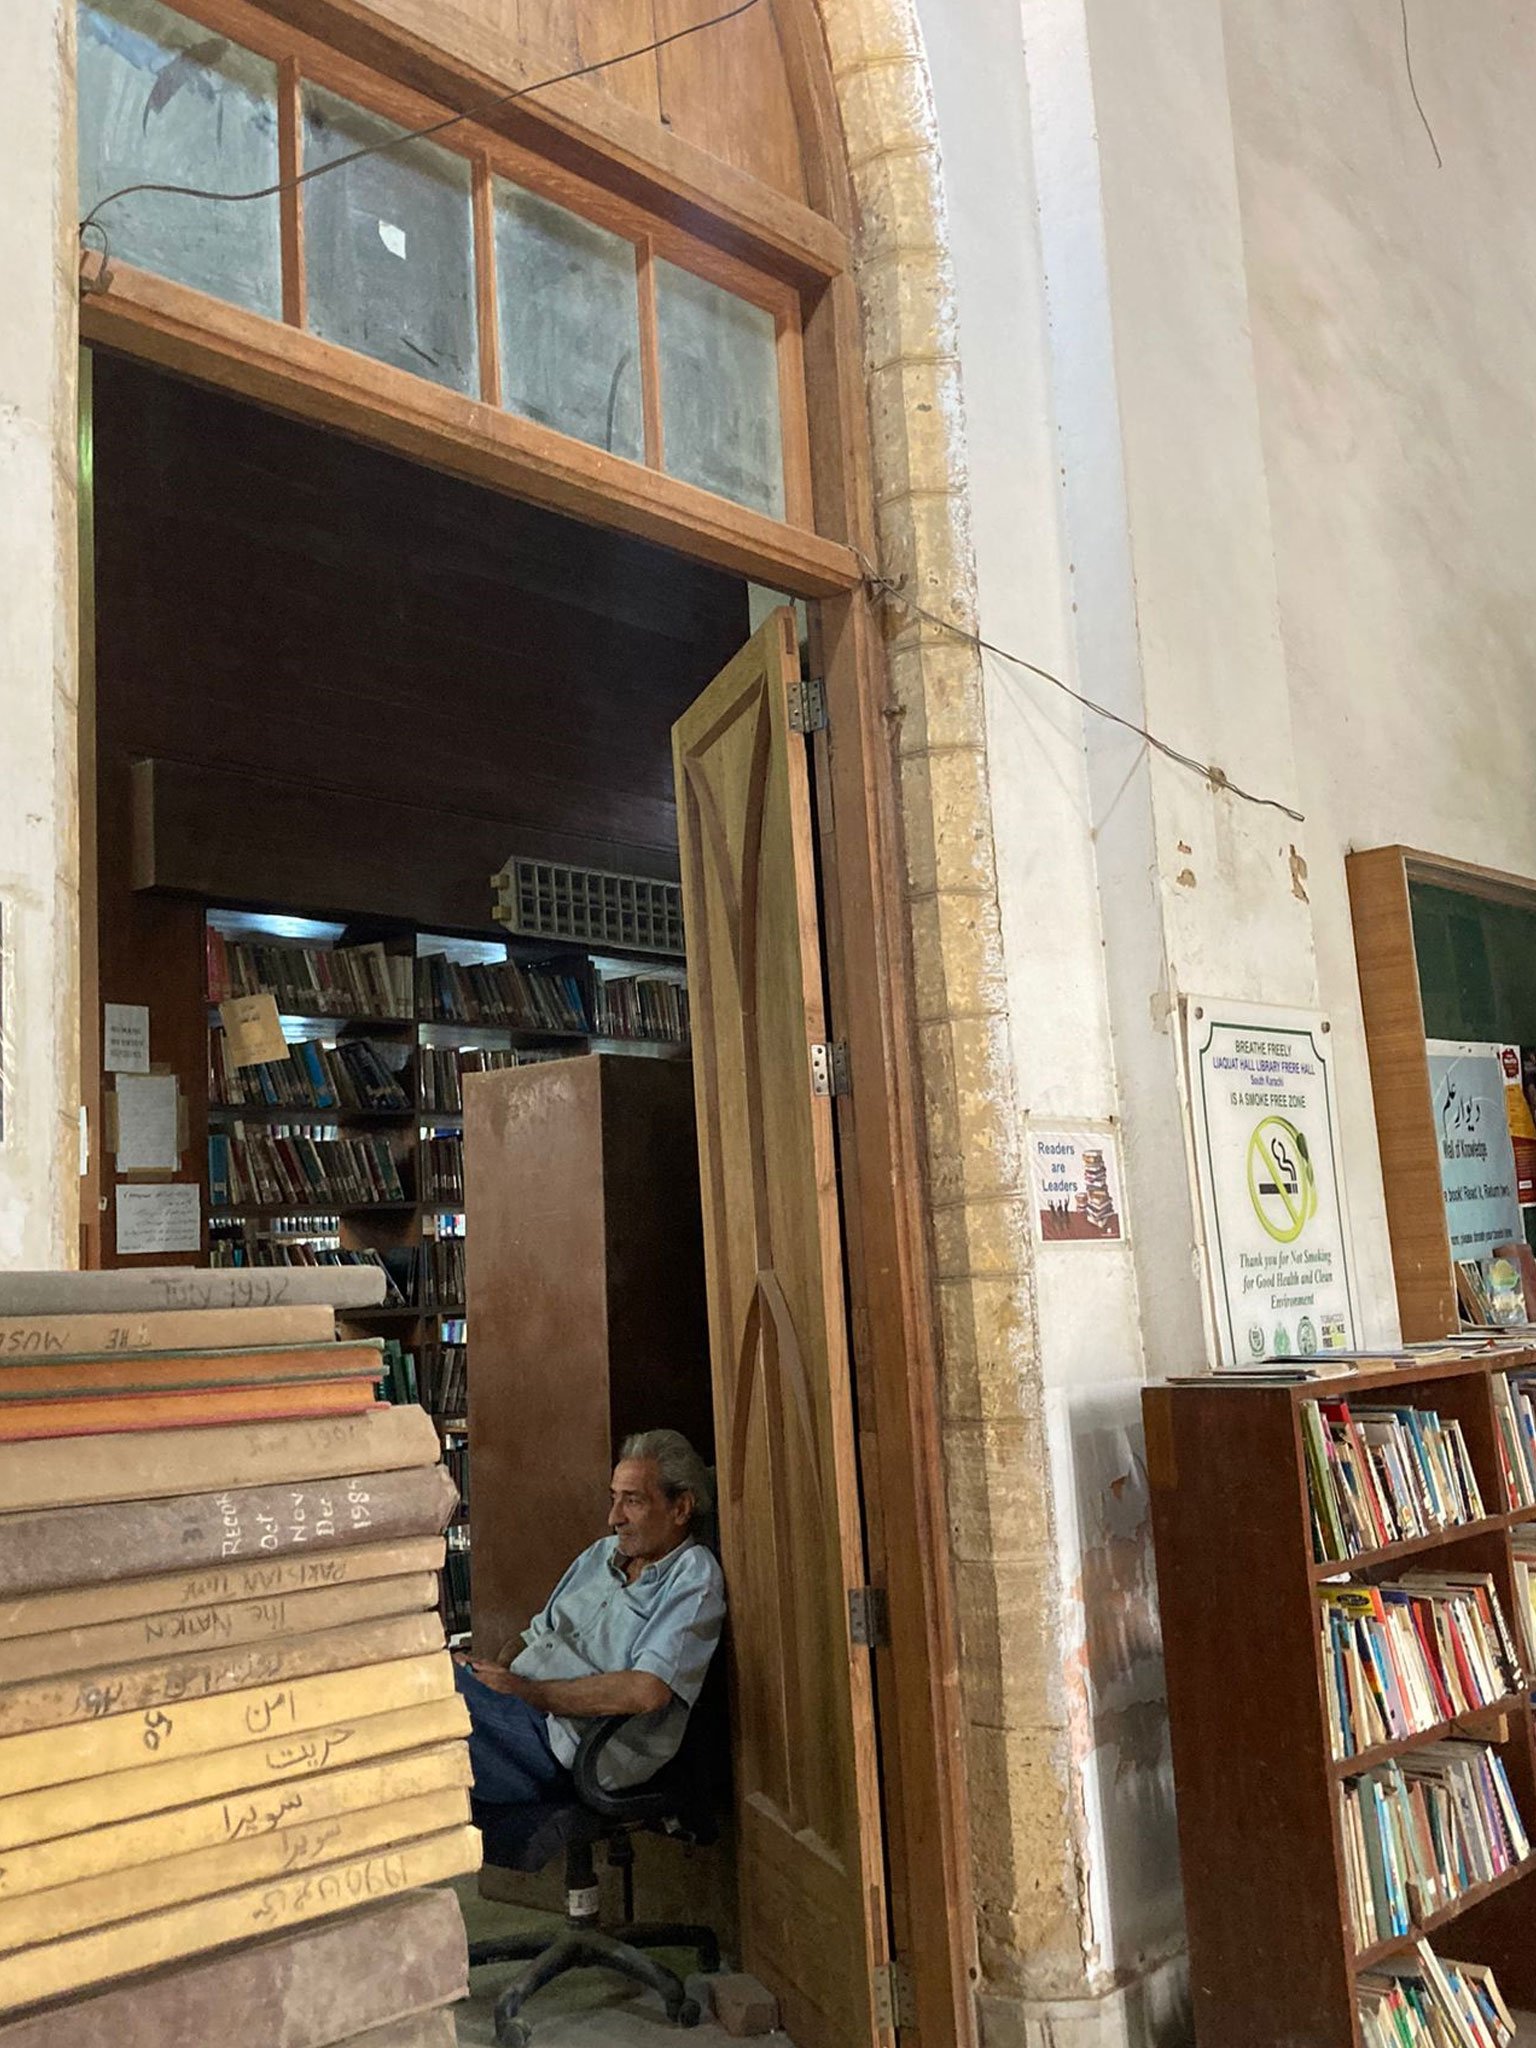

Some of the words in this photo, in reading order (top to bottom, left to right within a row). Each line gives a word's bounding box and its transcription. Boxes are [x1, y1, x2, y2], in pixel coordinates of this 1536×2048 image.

[1235, 1040, 1267, 1055] BREATHE
[1267, 1043, 1291, 1057] FREELY
[1213, 1056, 1239, 1069] LIAQUAT
[1240, 1059, 1255, 1071] HALL
[1256, 1059, 1280, 1072] LIBRARY
[1281, 1061, 1300, 1074] FRERE
[1301, 1064, 1316, 1075] HALL
[1231, 1092, 1238, 1105] IS
[1239, 1093, 1245, 1105] A
[1245, 1092, 1269, 1106] SMOKE
[1270, 1094, 1288, 1107] FREE
[1288, 1095, 1306, 1108] ZONE
[1038, 1142, 1075, 1155] Readers
[1461, 1139, 1487, 1162] Knowledge
[1051, 1163, 1066, 1173] are
[1042, 1179, 1078, 1192] Leaders
[1240, 1252, 1263, 1268] Thank
[1264, 1255, 1277, 1269] you
[1278, 1251, 1289, 1269] for
[1291, 1250, 1303, 1264] Not
[1304, 1248, 1331, 1265] Smoking
[1242, 1275, 1254, 1294] for
[1256, 1273, 1275, 1289] Good
[1277, 1271, 1299, 1287] Health
[1301, 1271, 1313, 1285] and
[1314, 1269, 1333, 1284] Clean
[228, 1278, 290, 1308] 1992
[1271, 1294, 1314, 1309] Environment
[246, 1690, 295, 1733] امن
[266, 1728, 355, 1769] حریت
[223, 1794, 302, 1842] سویرا
